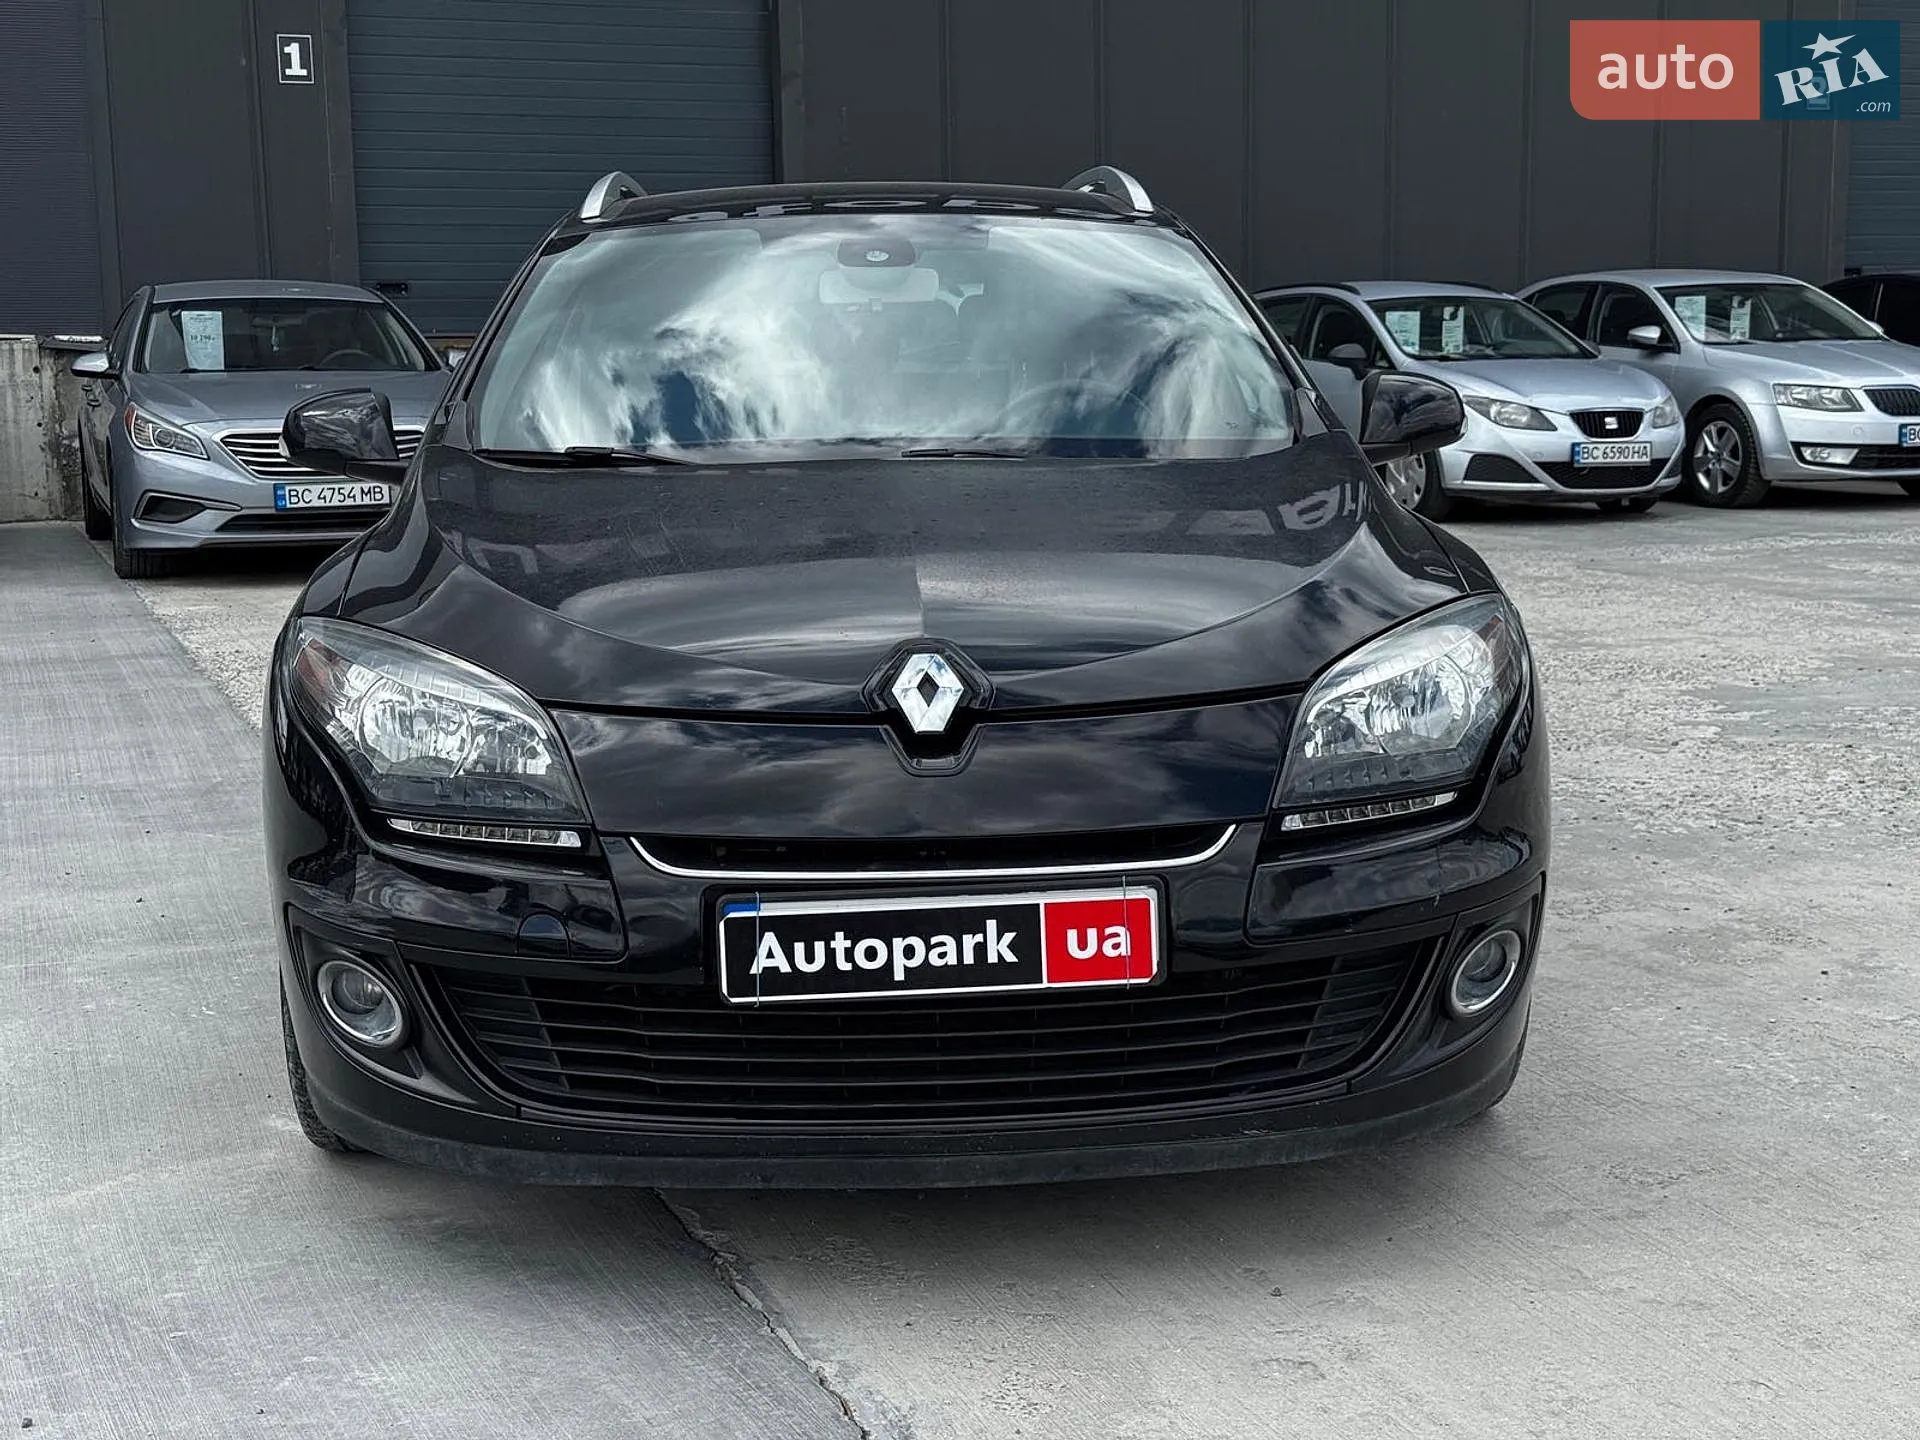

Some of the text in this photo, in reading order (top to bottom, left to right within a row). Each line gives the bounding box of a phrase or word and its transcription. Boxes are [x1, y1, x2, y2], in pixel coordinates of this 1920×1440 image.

[284, 42, 308, 76] 1
[1581, 445, 1649, 460] BC 6590 HA
[288, 485, 384, 505] BC 4754 MB
[749, 919, 1131, 981] Autopark ua
